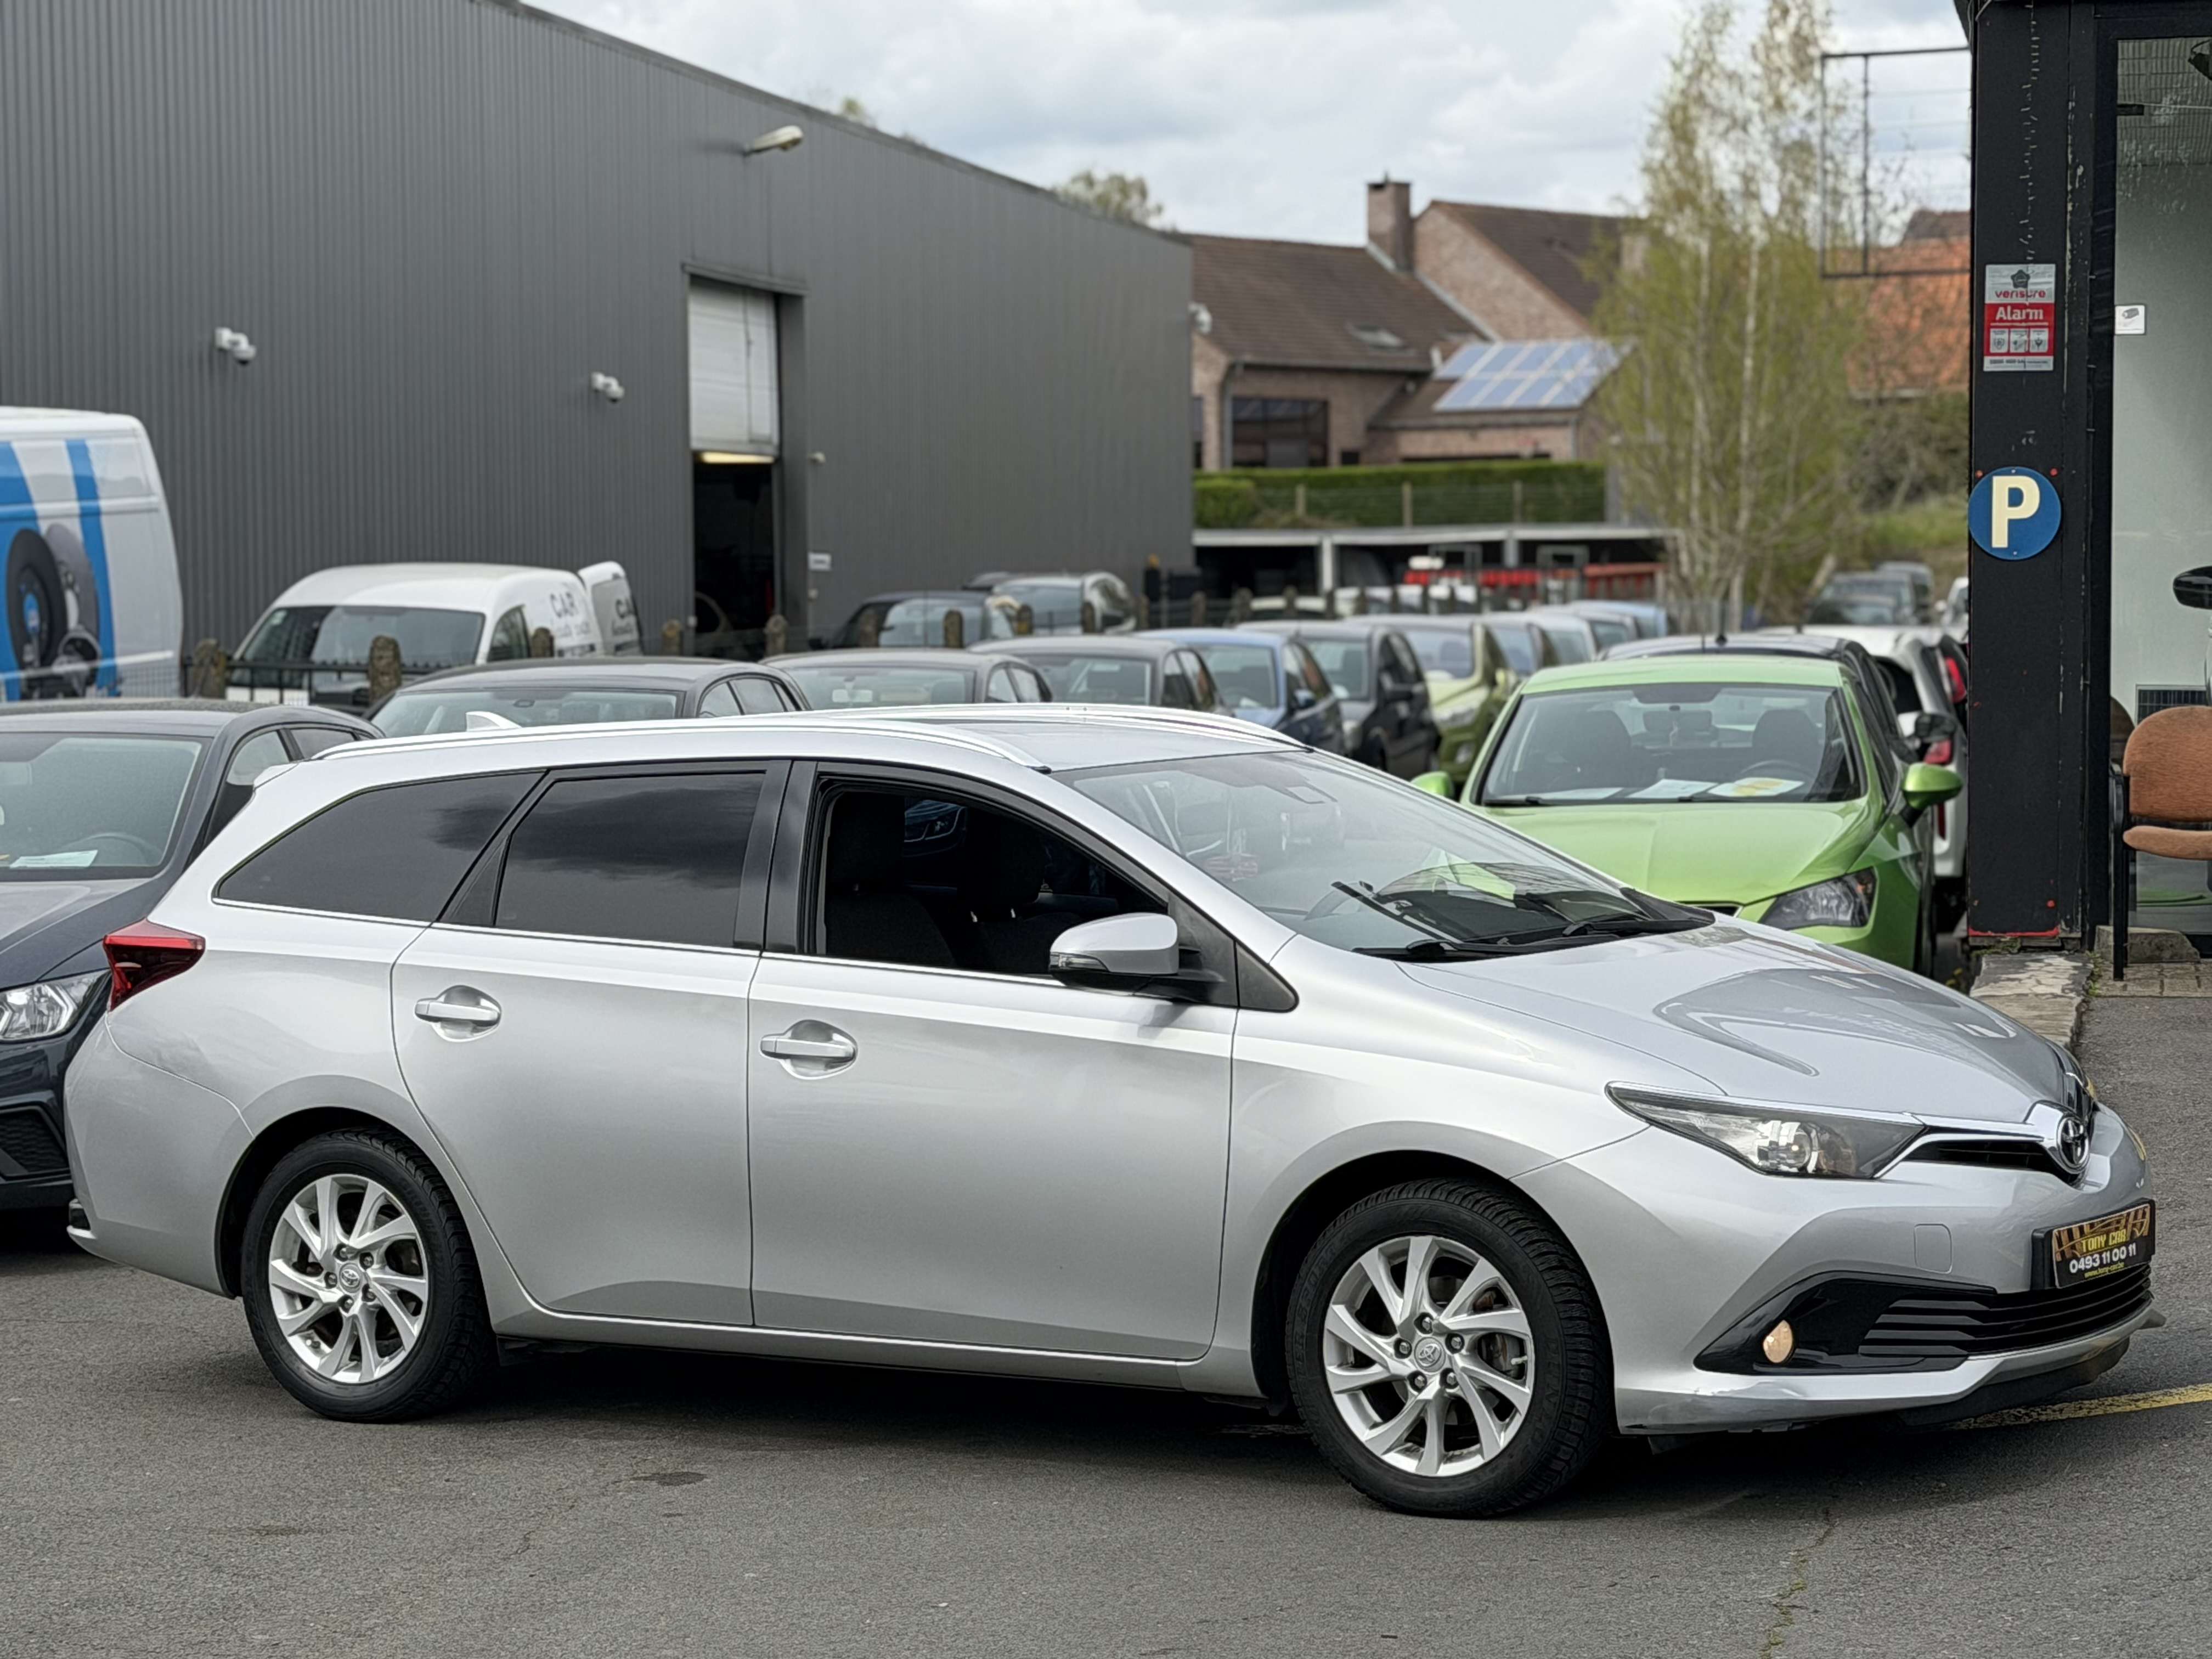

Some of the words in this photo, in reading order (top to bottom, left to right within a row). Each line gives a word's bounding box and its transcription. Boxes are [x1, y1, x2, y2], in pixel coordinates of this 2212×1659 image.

[1995, 290, 2046, 298] verisure
[1996, 306, 2044, 320] Alarm
[1992, 476, 2040, 548] P
[2081, 1235, 2106, 1252] TONY
[2109, 1229, 2126, 1245] CAR
[2069, 1254, 2100, 1273] 0493
[2102, 1251, 2111, 1264] 11
[2112, 1246, 2127, 1261] 00
[2128, 1243, 2136, 1257] 11
